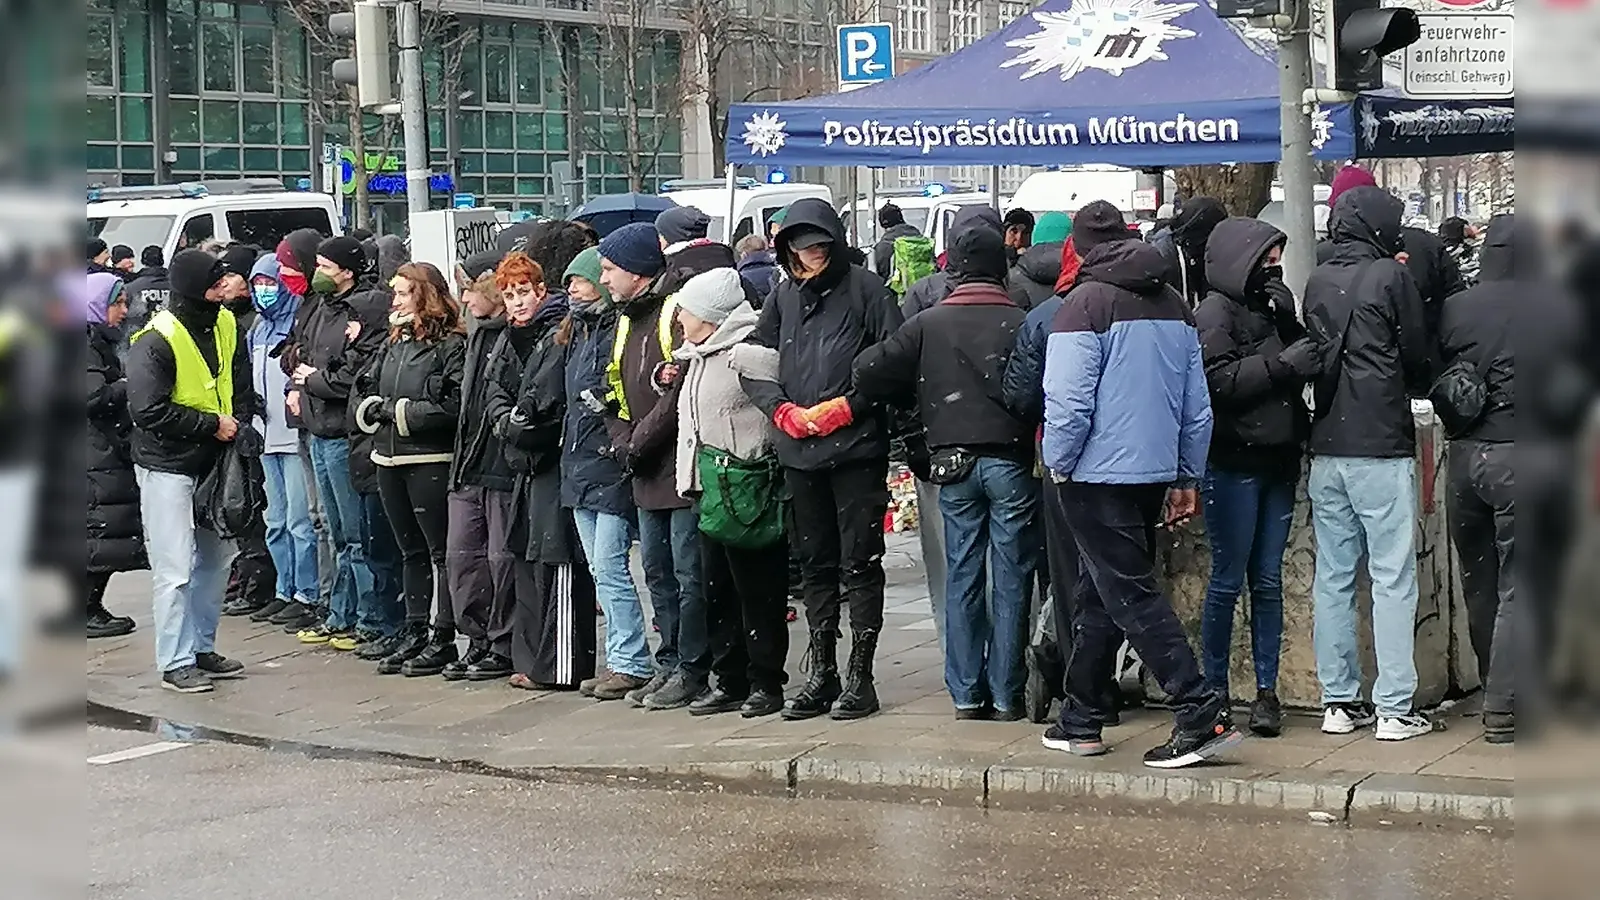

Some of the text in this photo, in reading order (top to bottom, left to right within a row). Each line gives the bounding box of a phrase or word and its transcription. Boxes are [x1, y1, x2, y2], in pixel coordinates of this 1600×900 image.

[847, 31, 877, 76] P
[1415, 46, 1506, 63] anfahrtzone
[1461, 70, 1511, 86] Gehweg)
[823, 113, 1239, 154] Polizeipräsidium München
